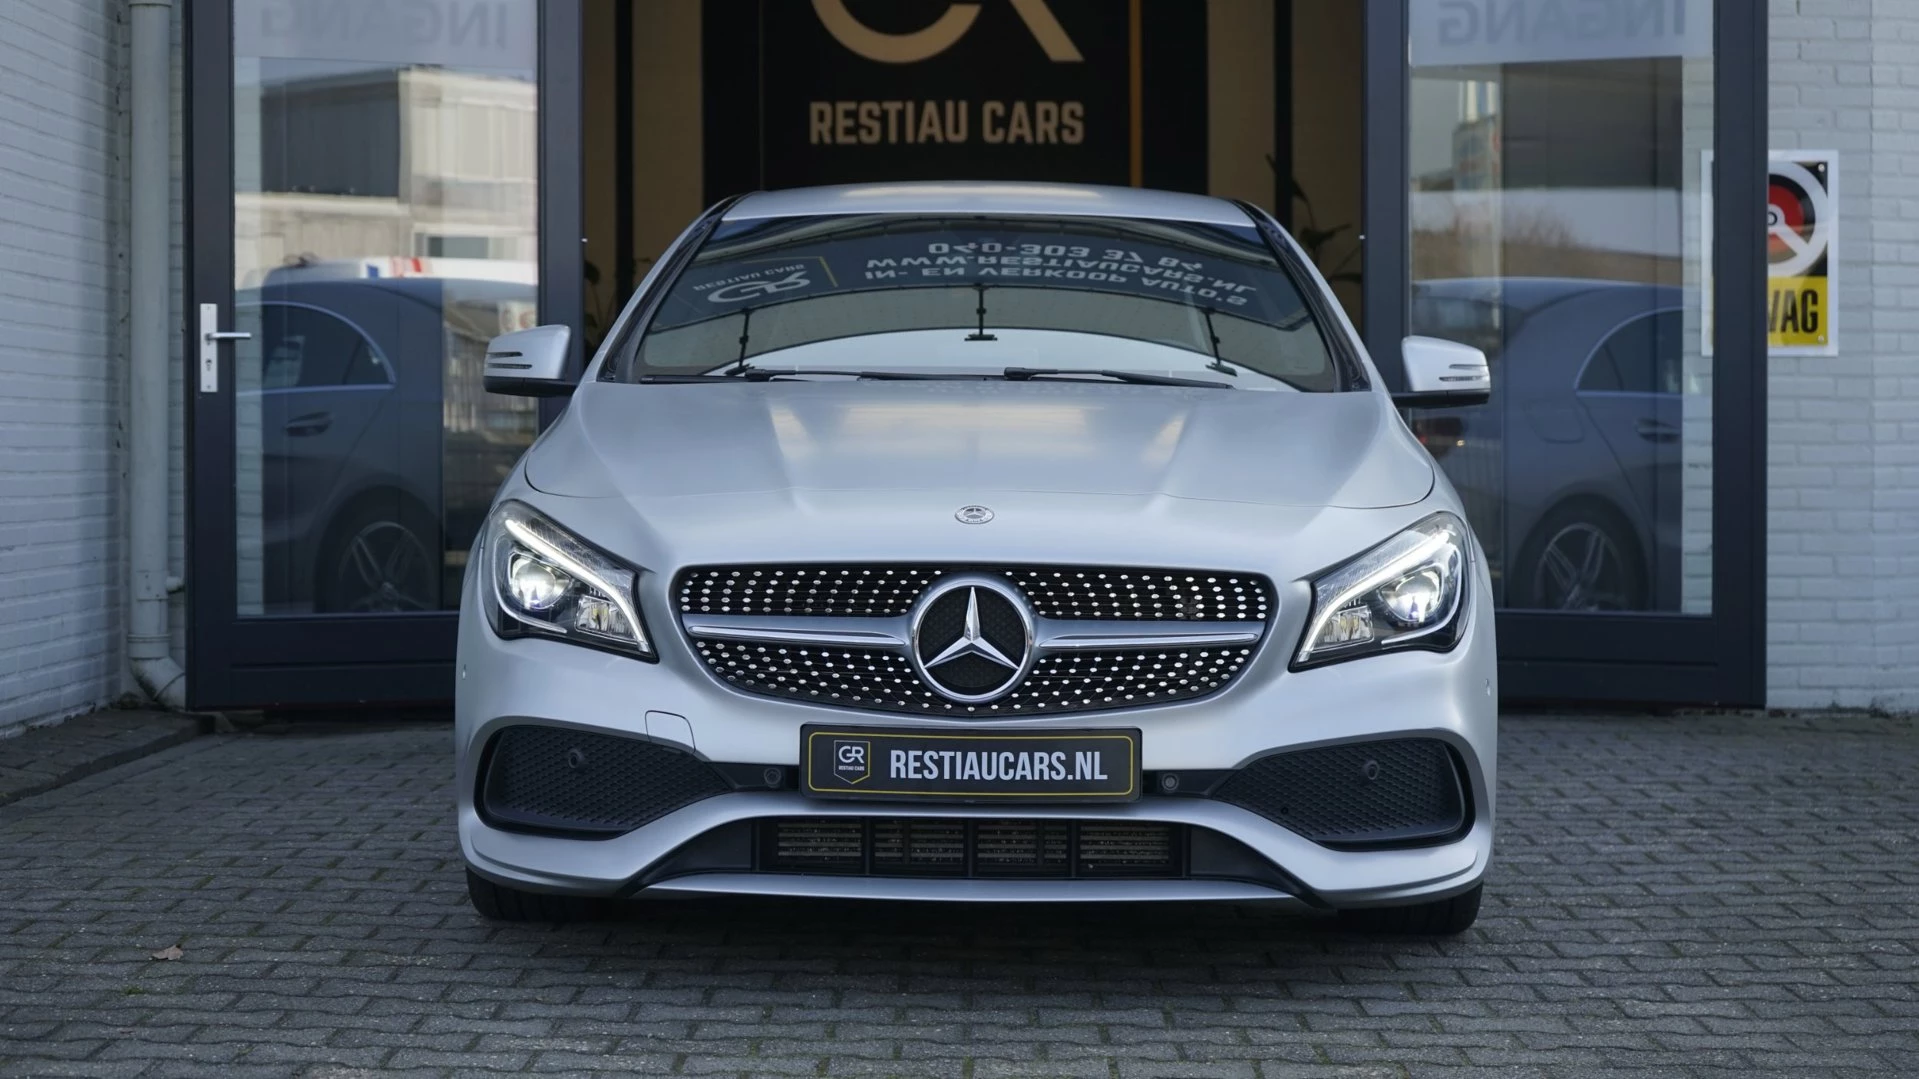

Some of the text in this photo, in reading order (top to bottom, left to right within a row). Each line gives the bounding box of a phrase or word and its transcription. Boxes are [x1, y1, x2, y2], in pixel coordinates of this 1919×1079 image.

[809, 101, 1085, 145] RESTIAU CARS
[890, 750, 1108, 781] RESTIAUCARS.NL
